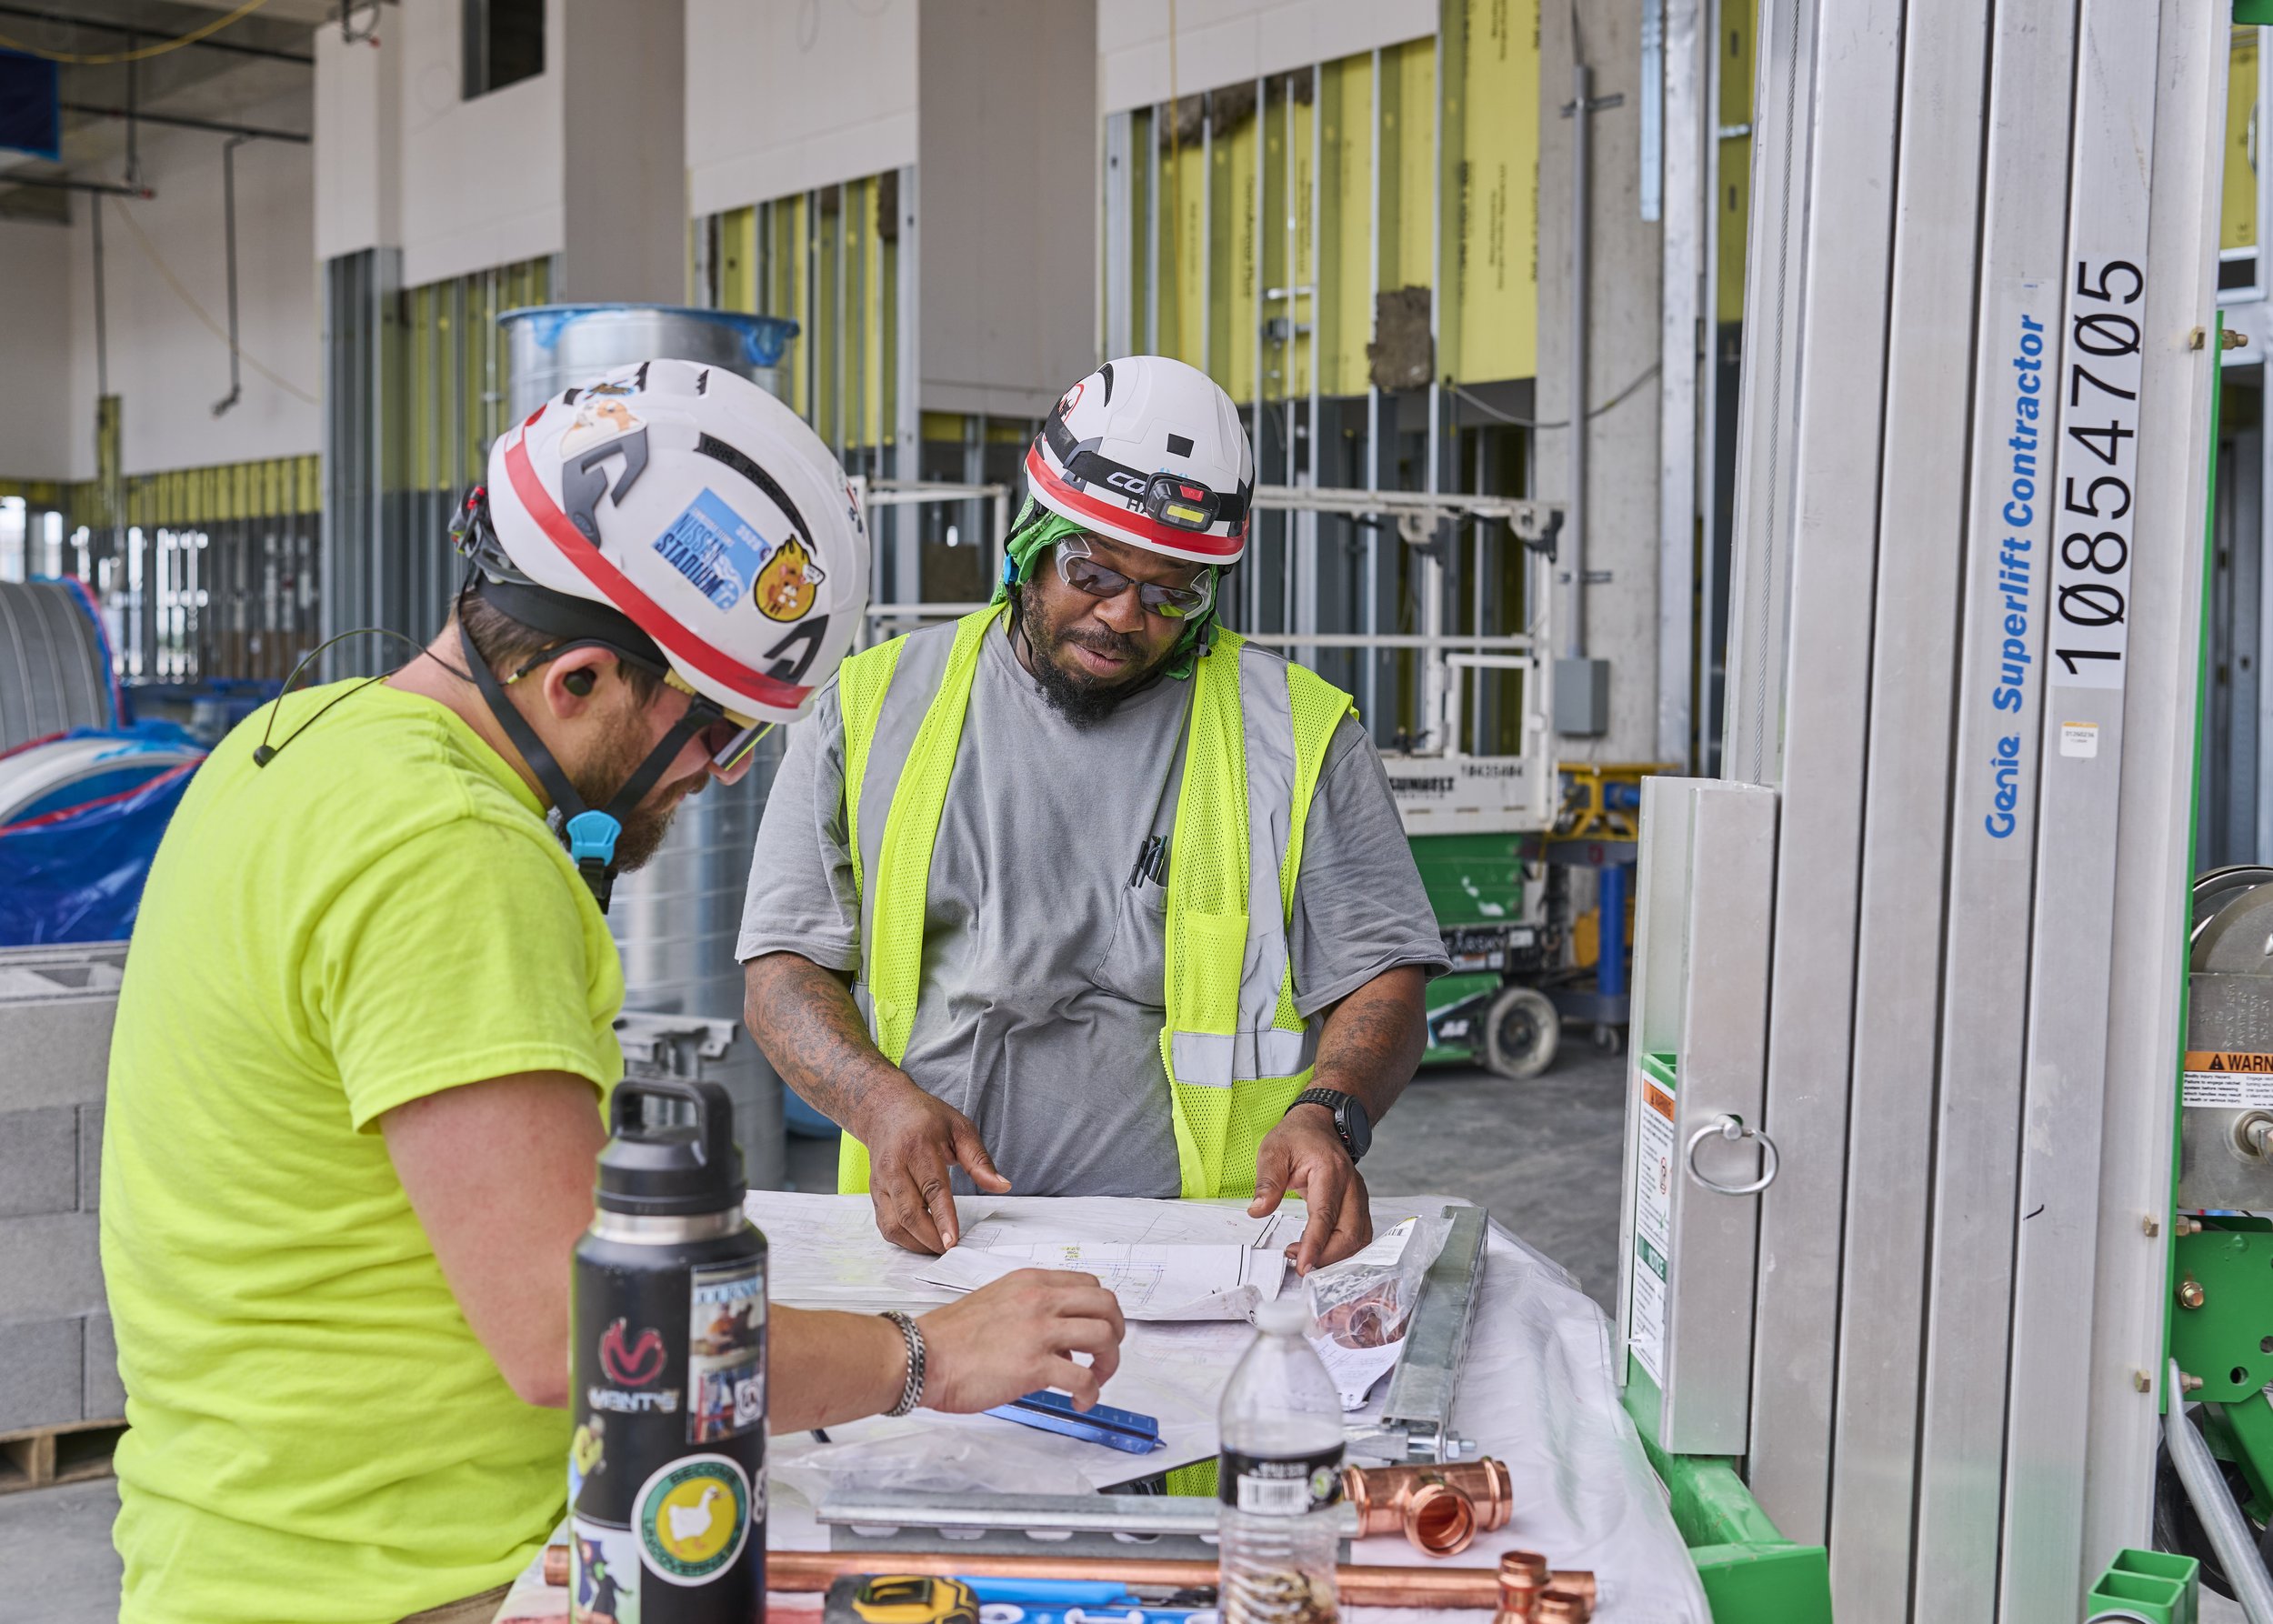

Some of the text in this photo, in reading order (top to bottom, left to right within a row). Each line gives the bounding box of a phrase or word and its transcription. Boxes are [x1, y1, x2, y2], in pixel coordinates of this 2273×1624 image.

[655, 533, 725, 597] STADIUM
[1106, 471, 1145, 495] CO
[1985, 314, 2045, 838] Genie Superlift Contractor
[2055, 260, 2144, 675] 10854705
